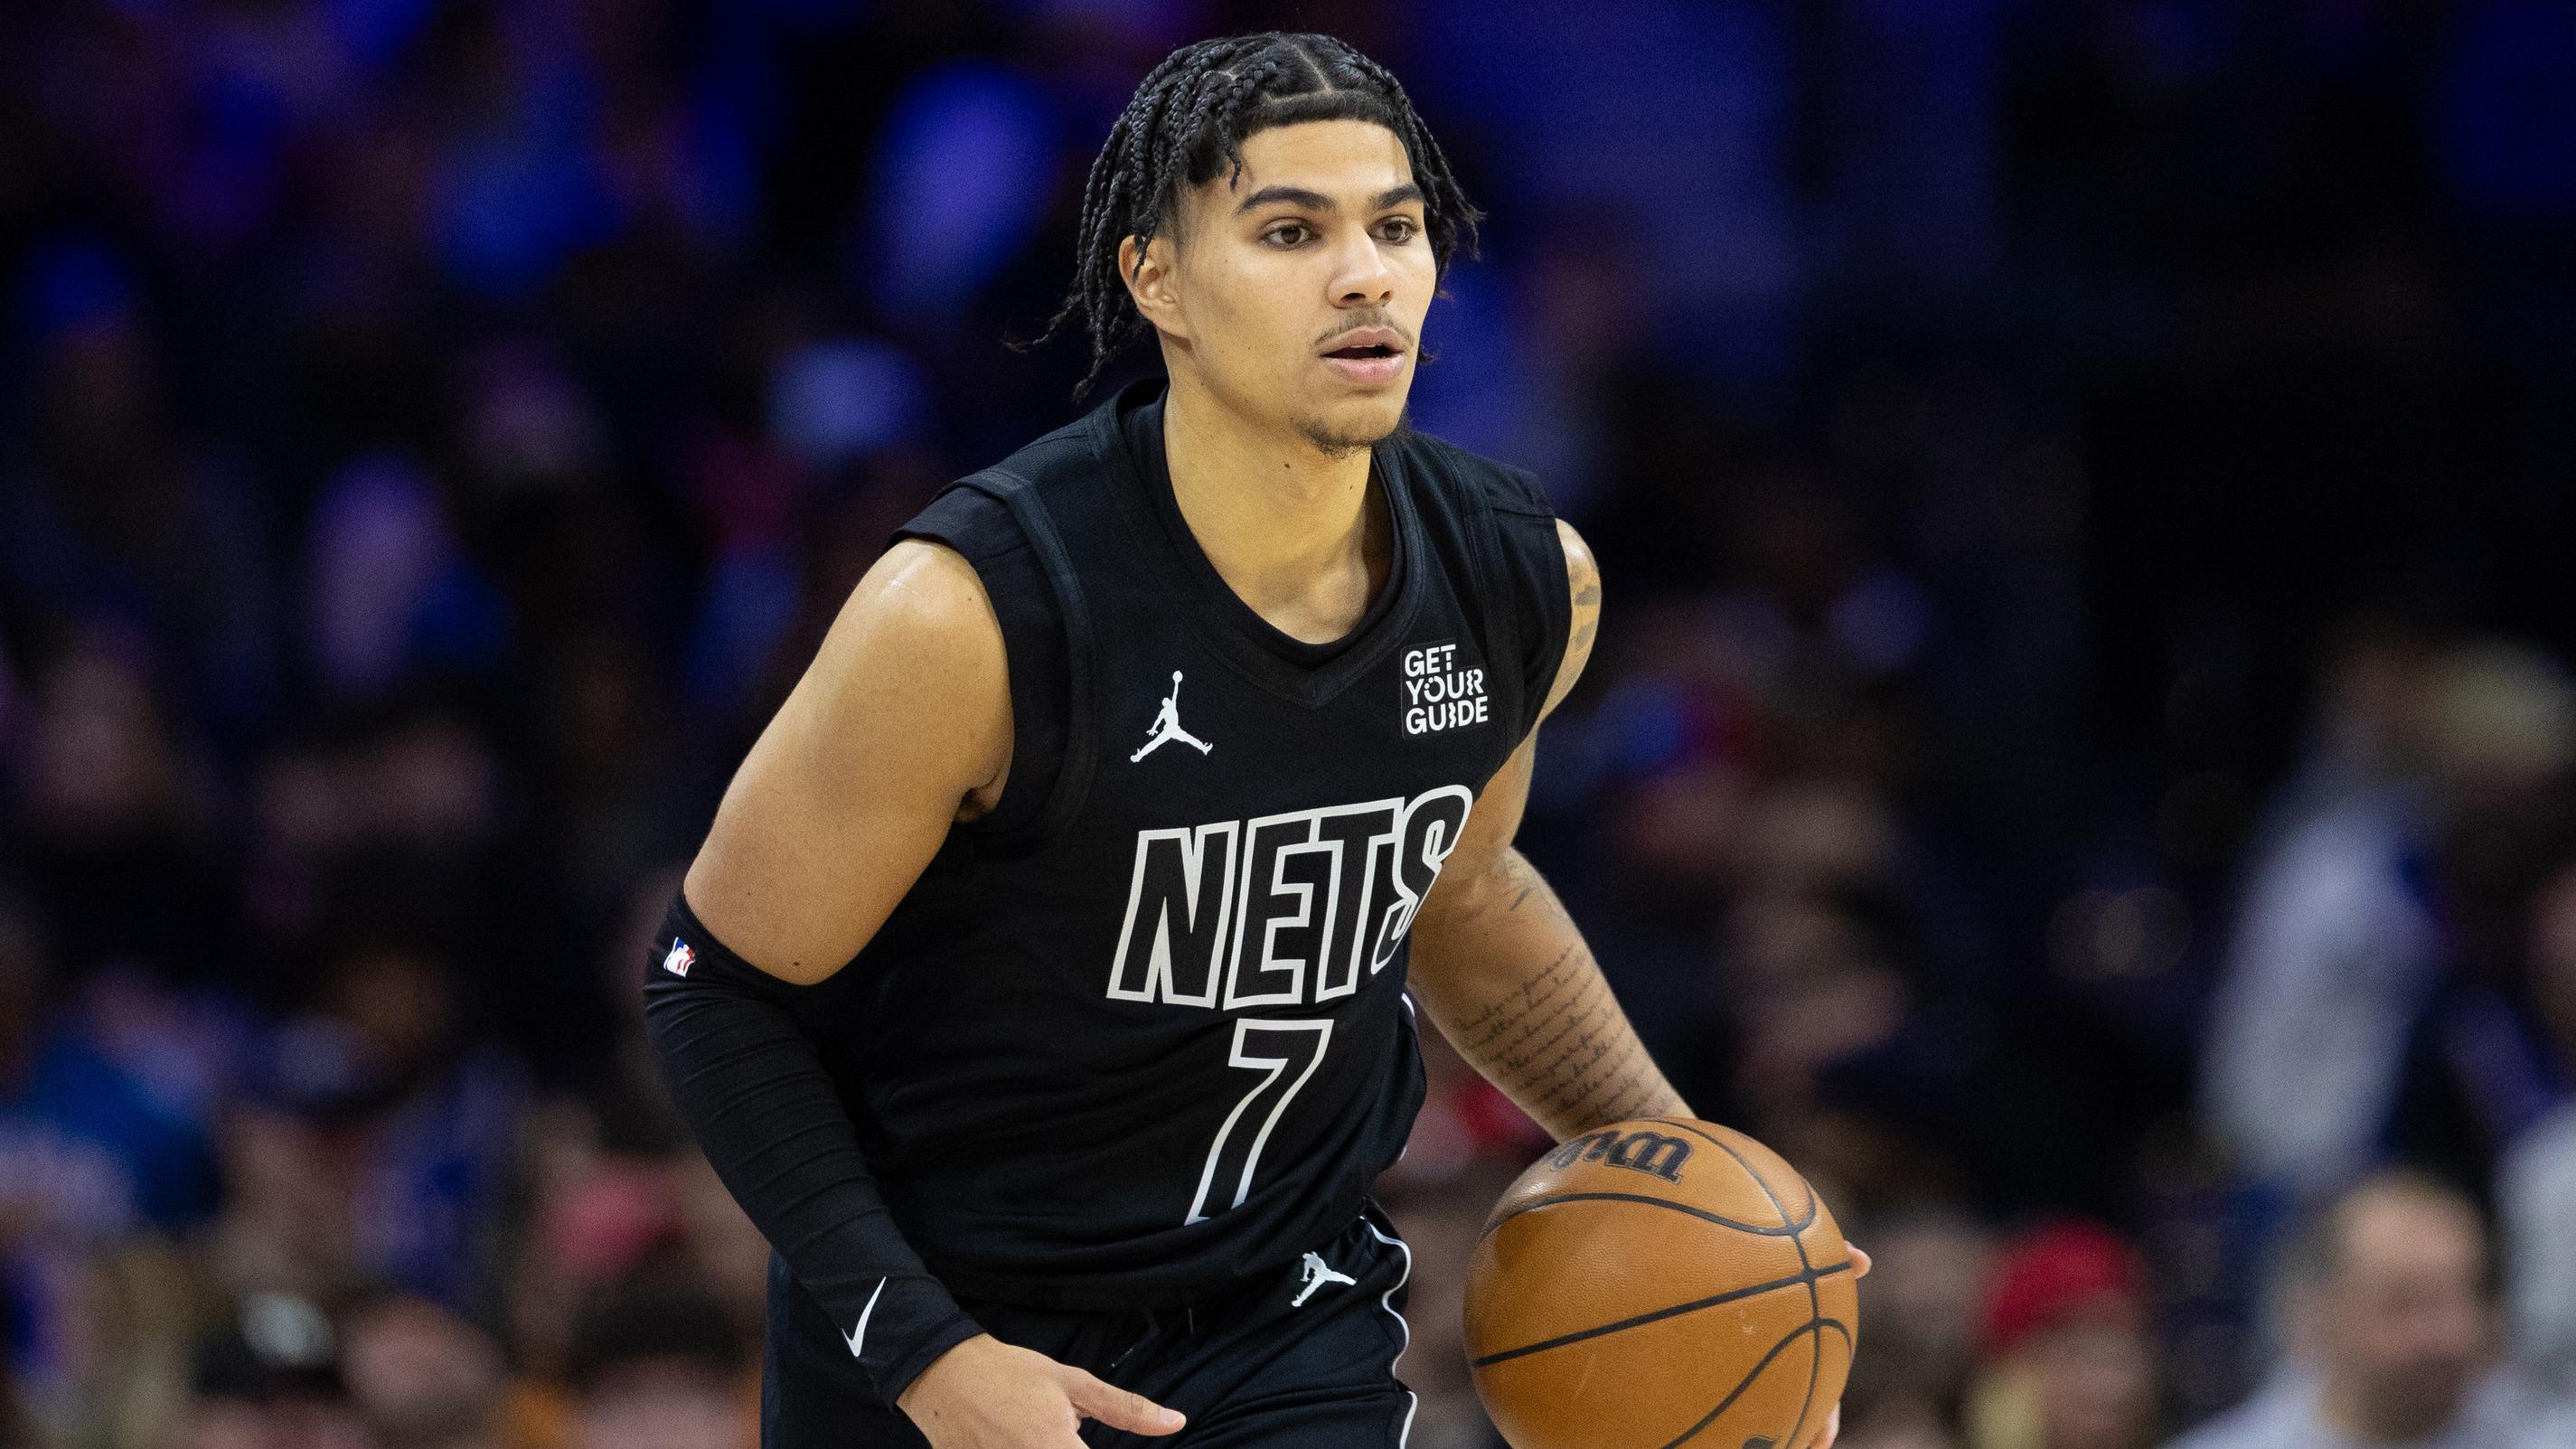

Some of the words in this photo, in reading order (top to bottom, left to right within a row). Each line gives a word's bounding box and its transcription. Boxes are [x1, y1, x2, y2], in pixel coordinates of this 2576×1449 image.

[1405, 644, 1456, 677] GET
[1406, 668, 1484, 705] YOUR
[1406, 695, 1489, 735] GUIDE
[1105, 784, 1473, 1011] NETS
[1184, 1018, 1334, 1226] 7
